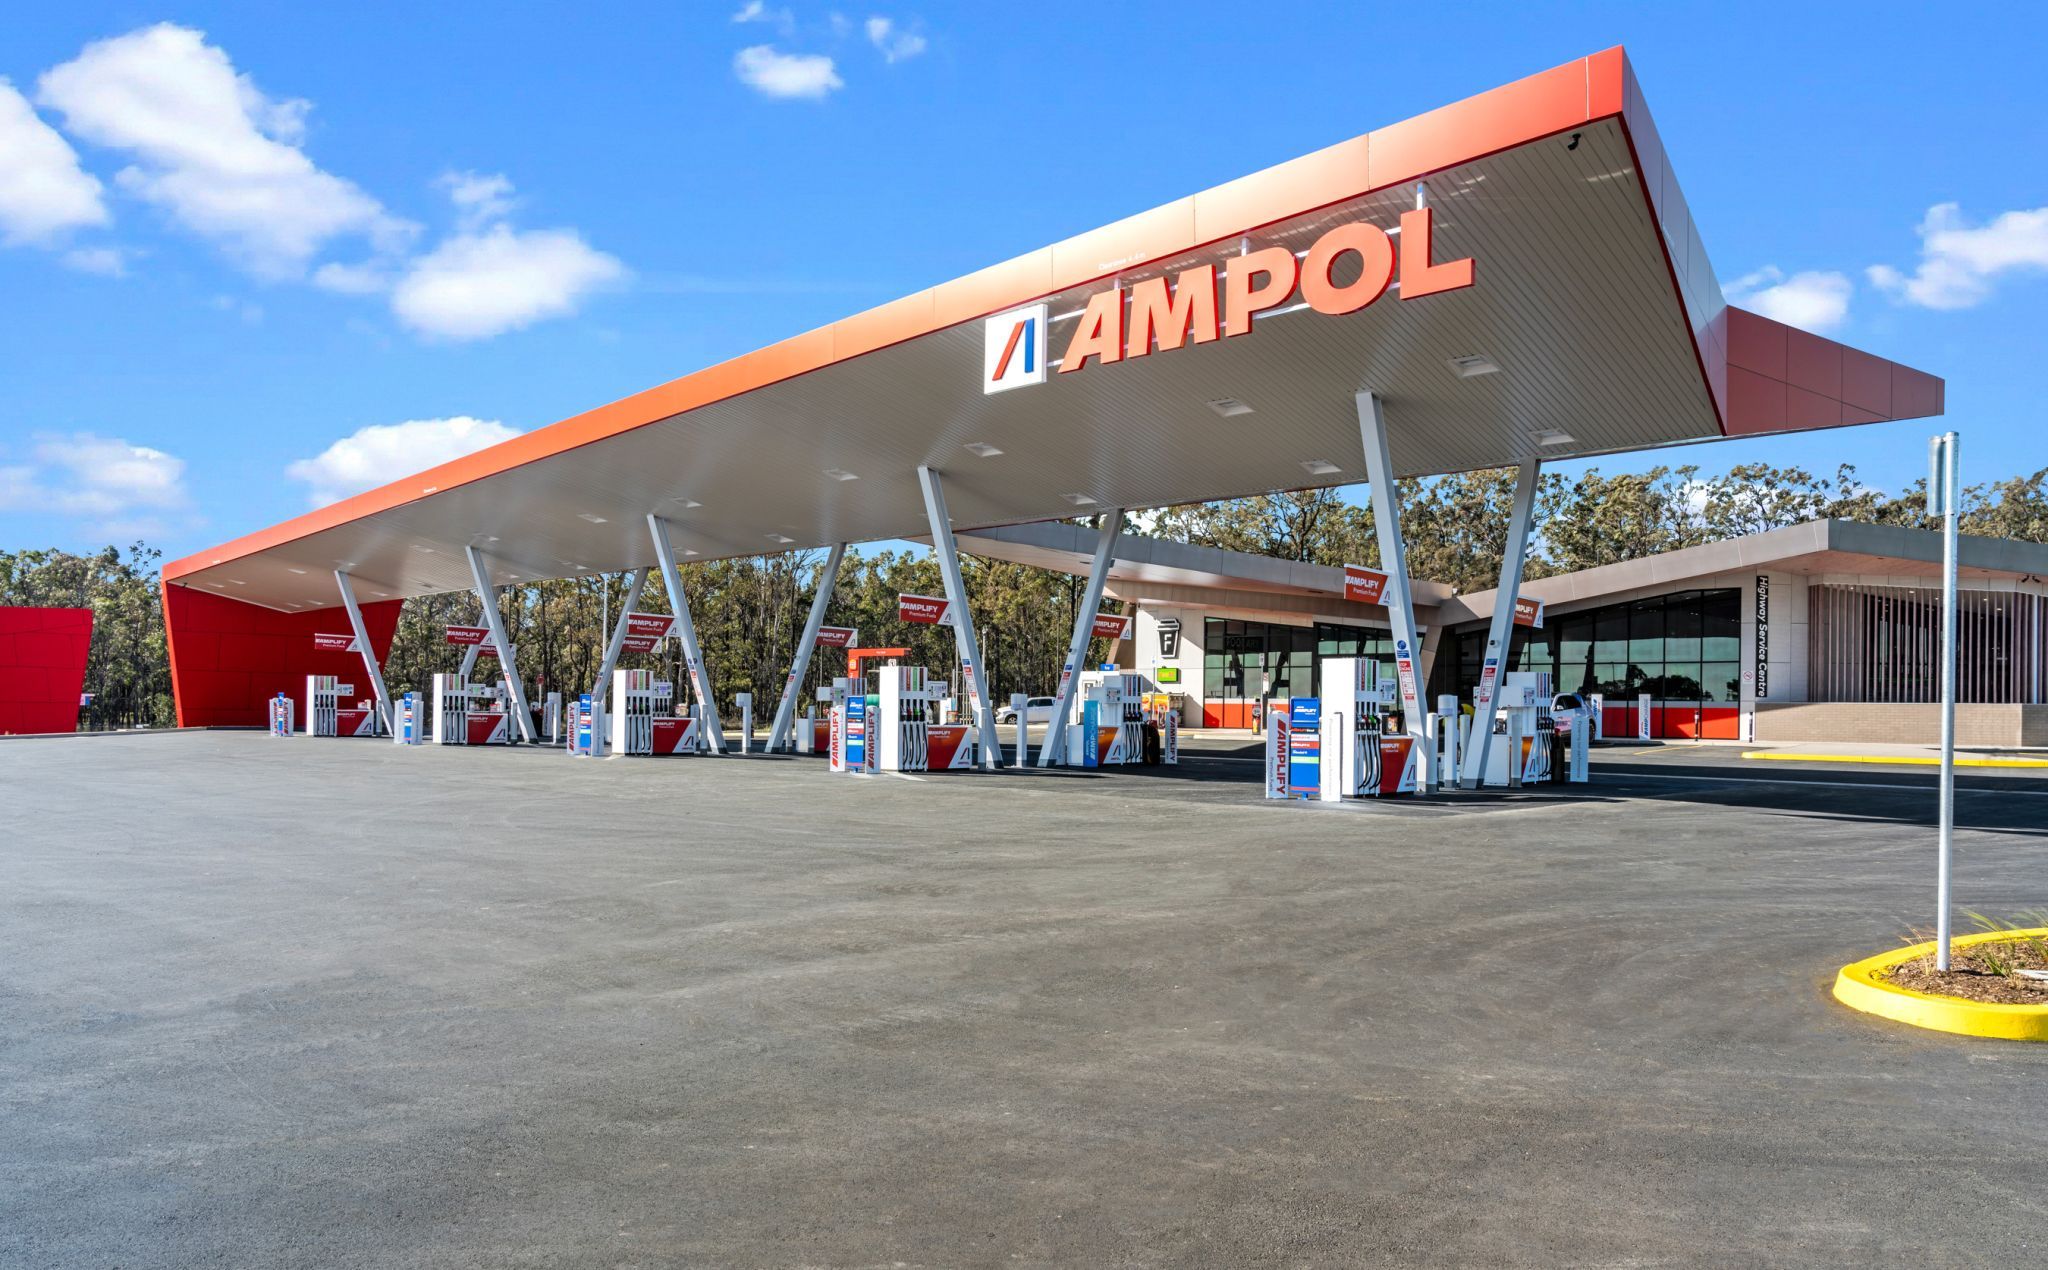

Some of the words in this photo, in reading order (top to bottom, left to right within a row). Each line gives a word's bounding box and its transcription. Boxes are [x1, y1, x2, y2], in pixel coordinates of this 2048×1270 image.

[1057, 207, 1476, 374] AMPOL
[1350, 576, 1379, 590] AMPLIFY
[1353, 587, 1368, 595] Premium
[1757, 576, 1768, 622] Highway
[903, 602, 939, 613] AMPLIFY
[1516, 604, 1534, 614] MPLIFY
[633, 619, 665, 627] AMPLIFY
[450, 630, 480, 638] AMPLIFY
[819, 631, 846, 639] AMPLIFY
[1164, 634, 1172, 651] F
[1759, 623, 1768, 660] Service
[1758, 662, 1767, 697] Centre
[1277, 732, 1286, 795] AMPLIFY
